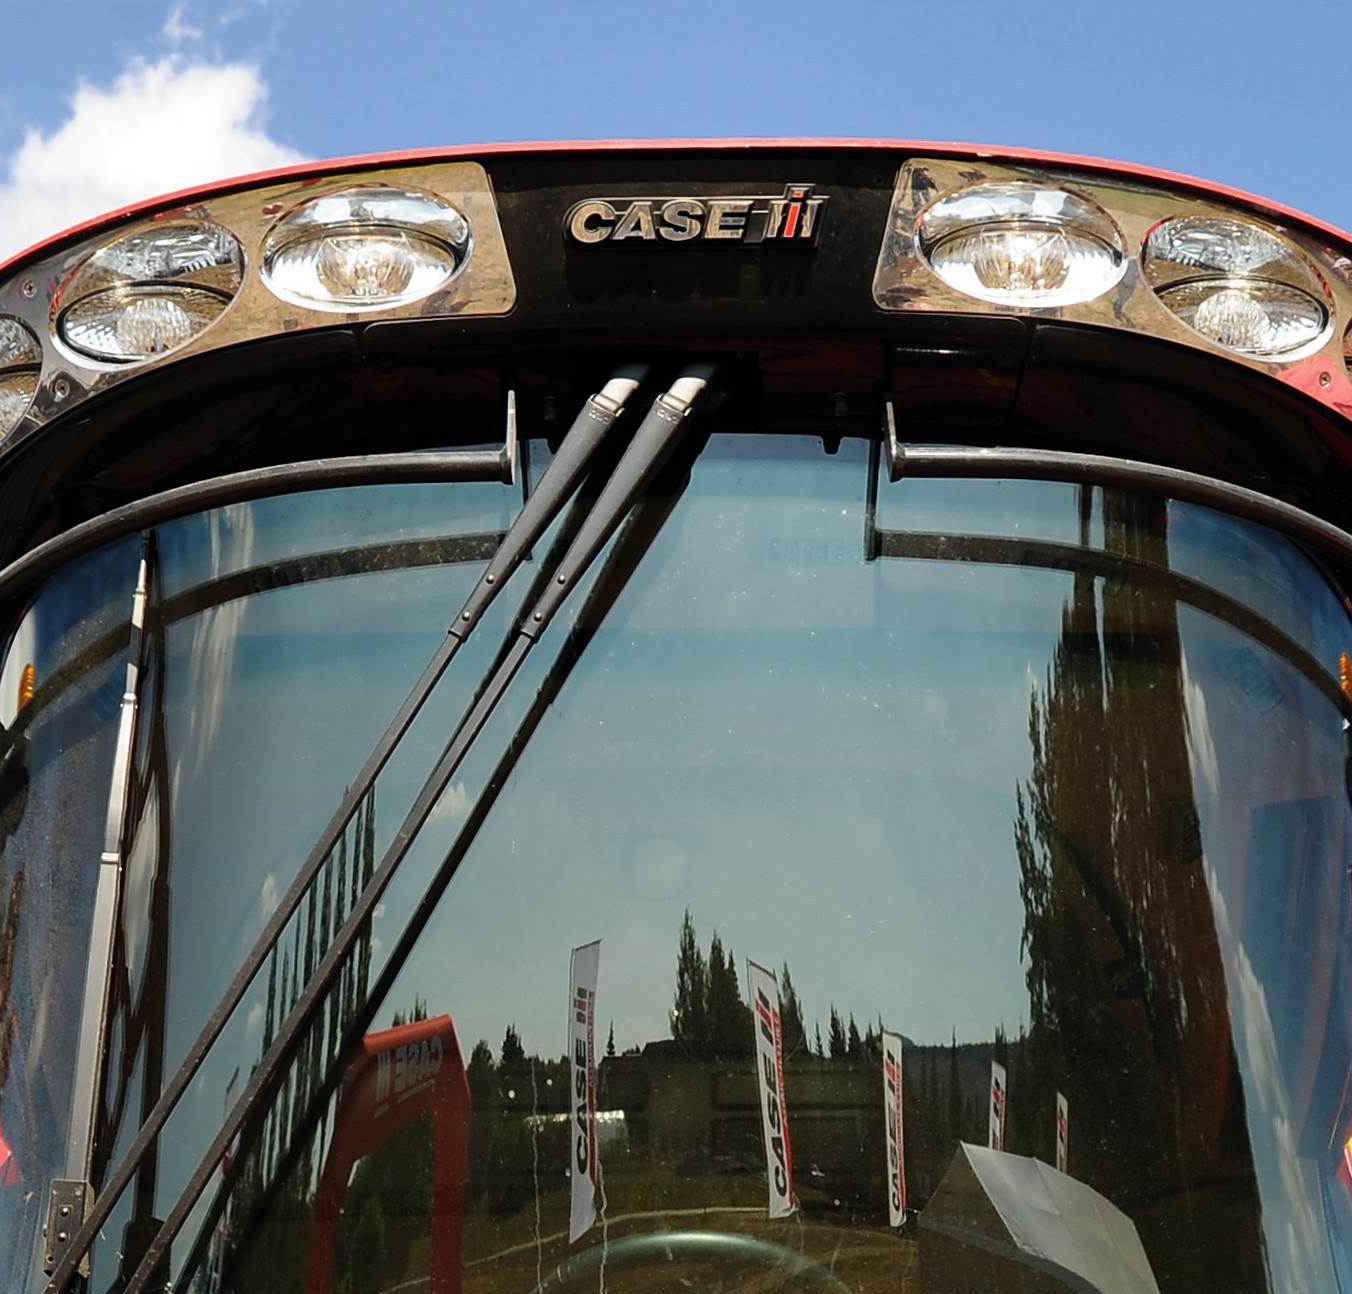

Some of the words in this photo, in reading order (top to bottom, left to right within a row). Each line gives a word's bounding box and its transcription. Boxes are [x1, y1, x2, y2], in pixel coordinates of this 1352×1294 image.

[569, 198, 754, 244] CASE
[573, 1037, 589, 1176] CASE
[762, 1053, 787, 1198] CASE
[888, 1102, 901, 1212] CASE
